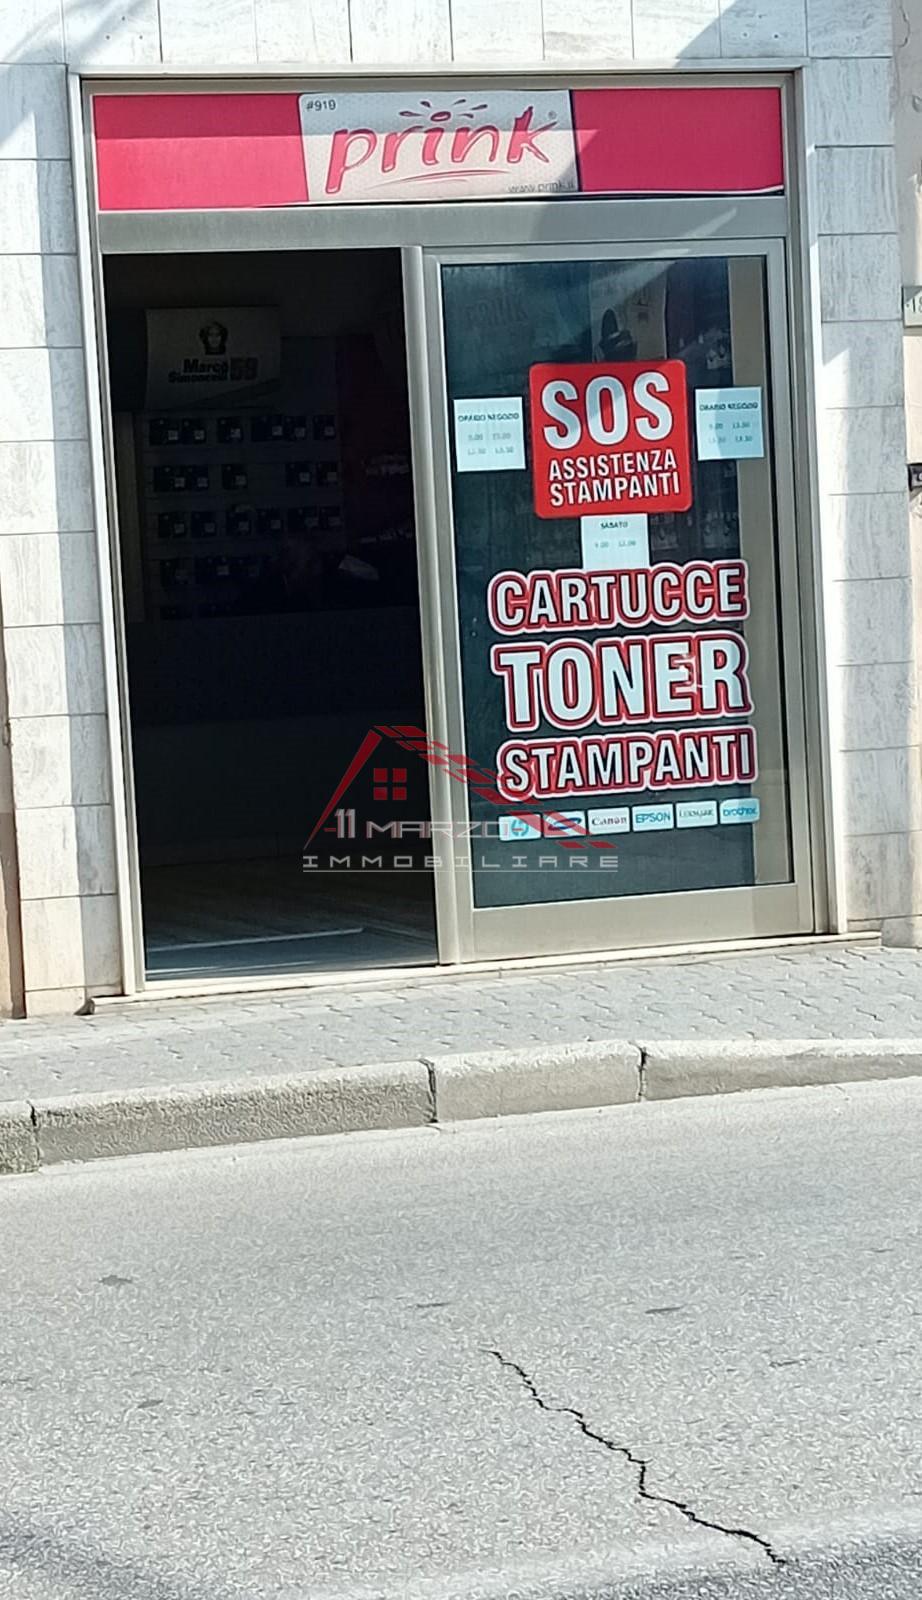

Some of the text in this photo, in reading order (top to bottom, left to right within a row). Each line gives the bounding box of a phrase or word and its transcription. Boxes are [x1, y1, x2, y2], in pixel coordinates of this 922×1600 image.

[325, 105, 558, 194] prink
[540, 370, 675, 451] SOS
[548, 449, 678, 482] ASSISTENZA
[549, 471, 681, 507] STAMPANTI
[495, 565, 744, 629] CARTUCCE
[497, 637, 747, 725] TONER
[502, 731, 752, 795] STAMPANTI
[591, 814, 629, 827] Canon
[635, 811, 672, 825] EPSON
